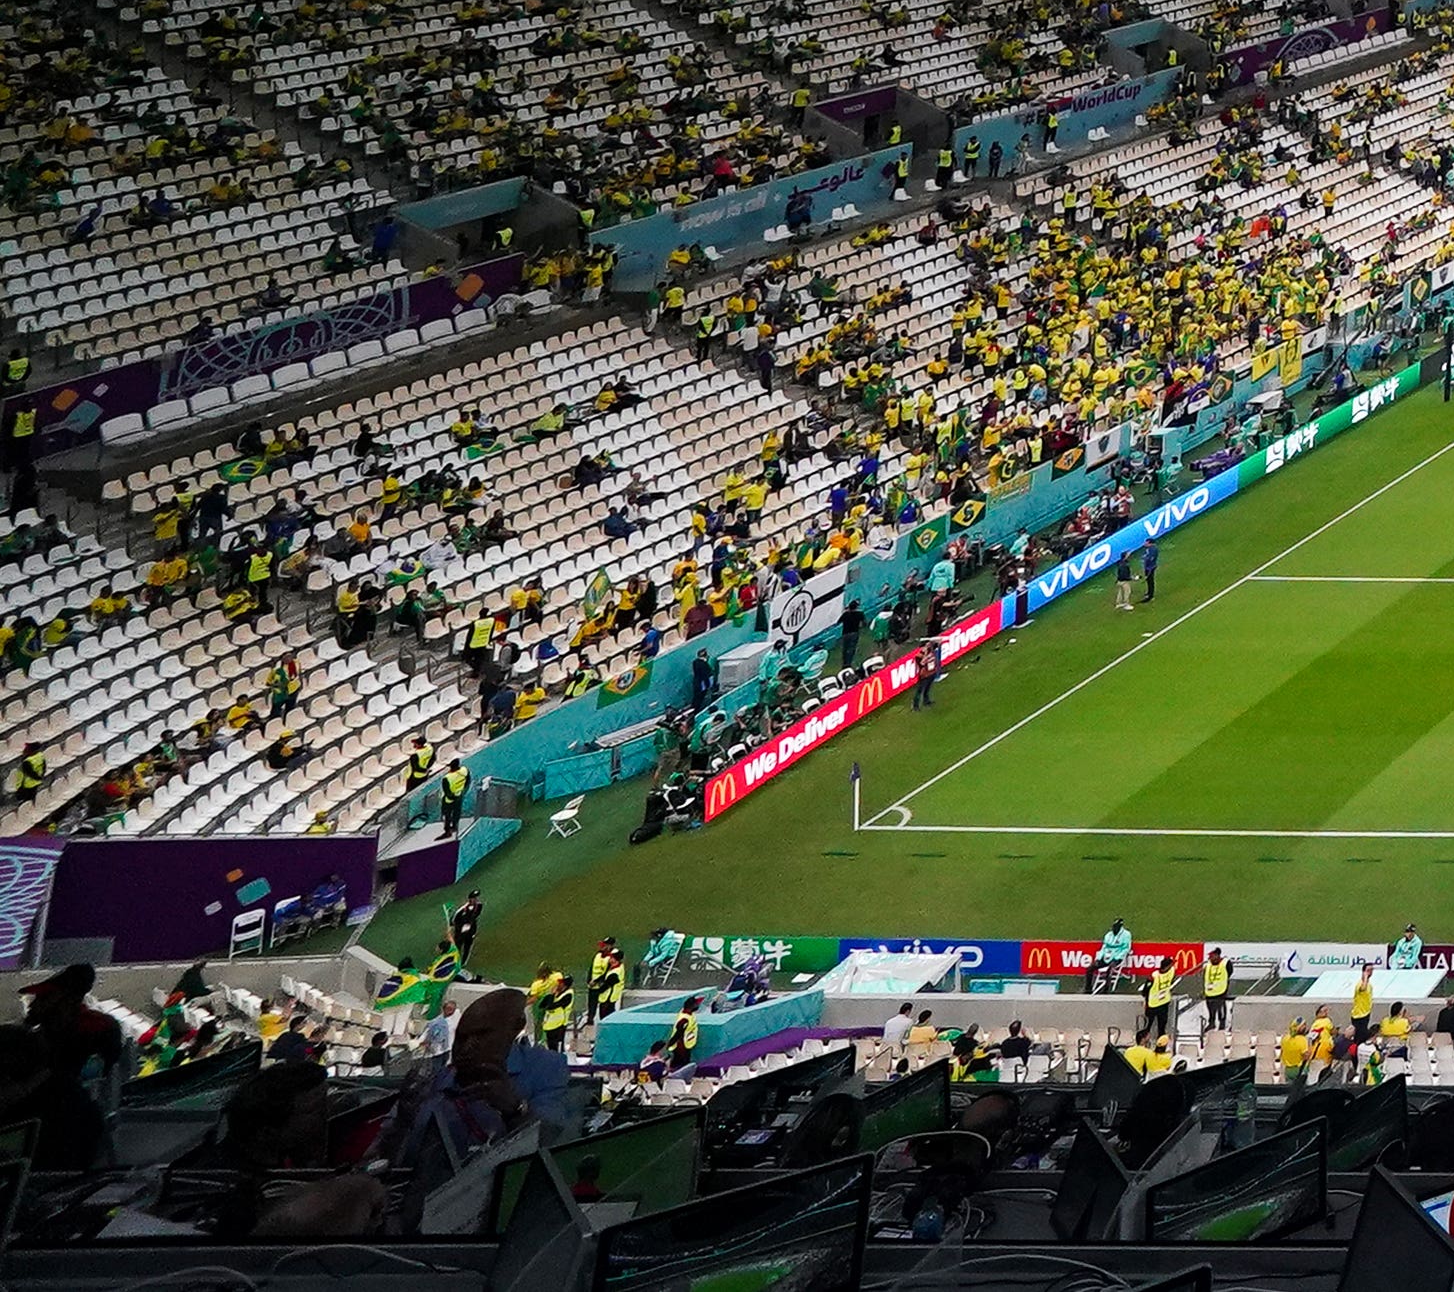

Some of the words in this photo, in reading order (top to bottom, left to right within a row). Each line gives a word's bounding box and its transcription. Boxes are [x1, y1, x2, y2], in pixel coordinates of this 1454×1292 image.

[1144, 487, 1210, 537] vivo
[1040, 543, 1111, 597] vivo
[743, 750, 776, 785] We
[778, 703, 848, 762] Deliver
[1061, 950, 1091, 968] We
